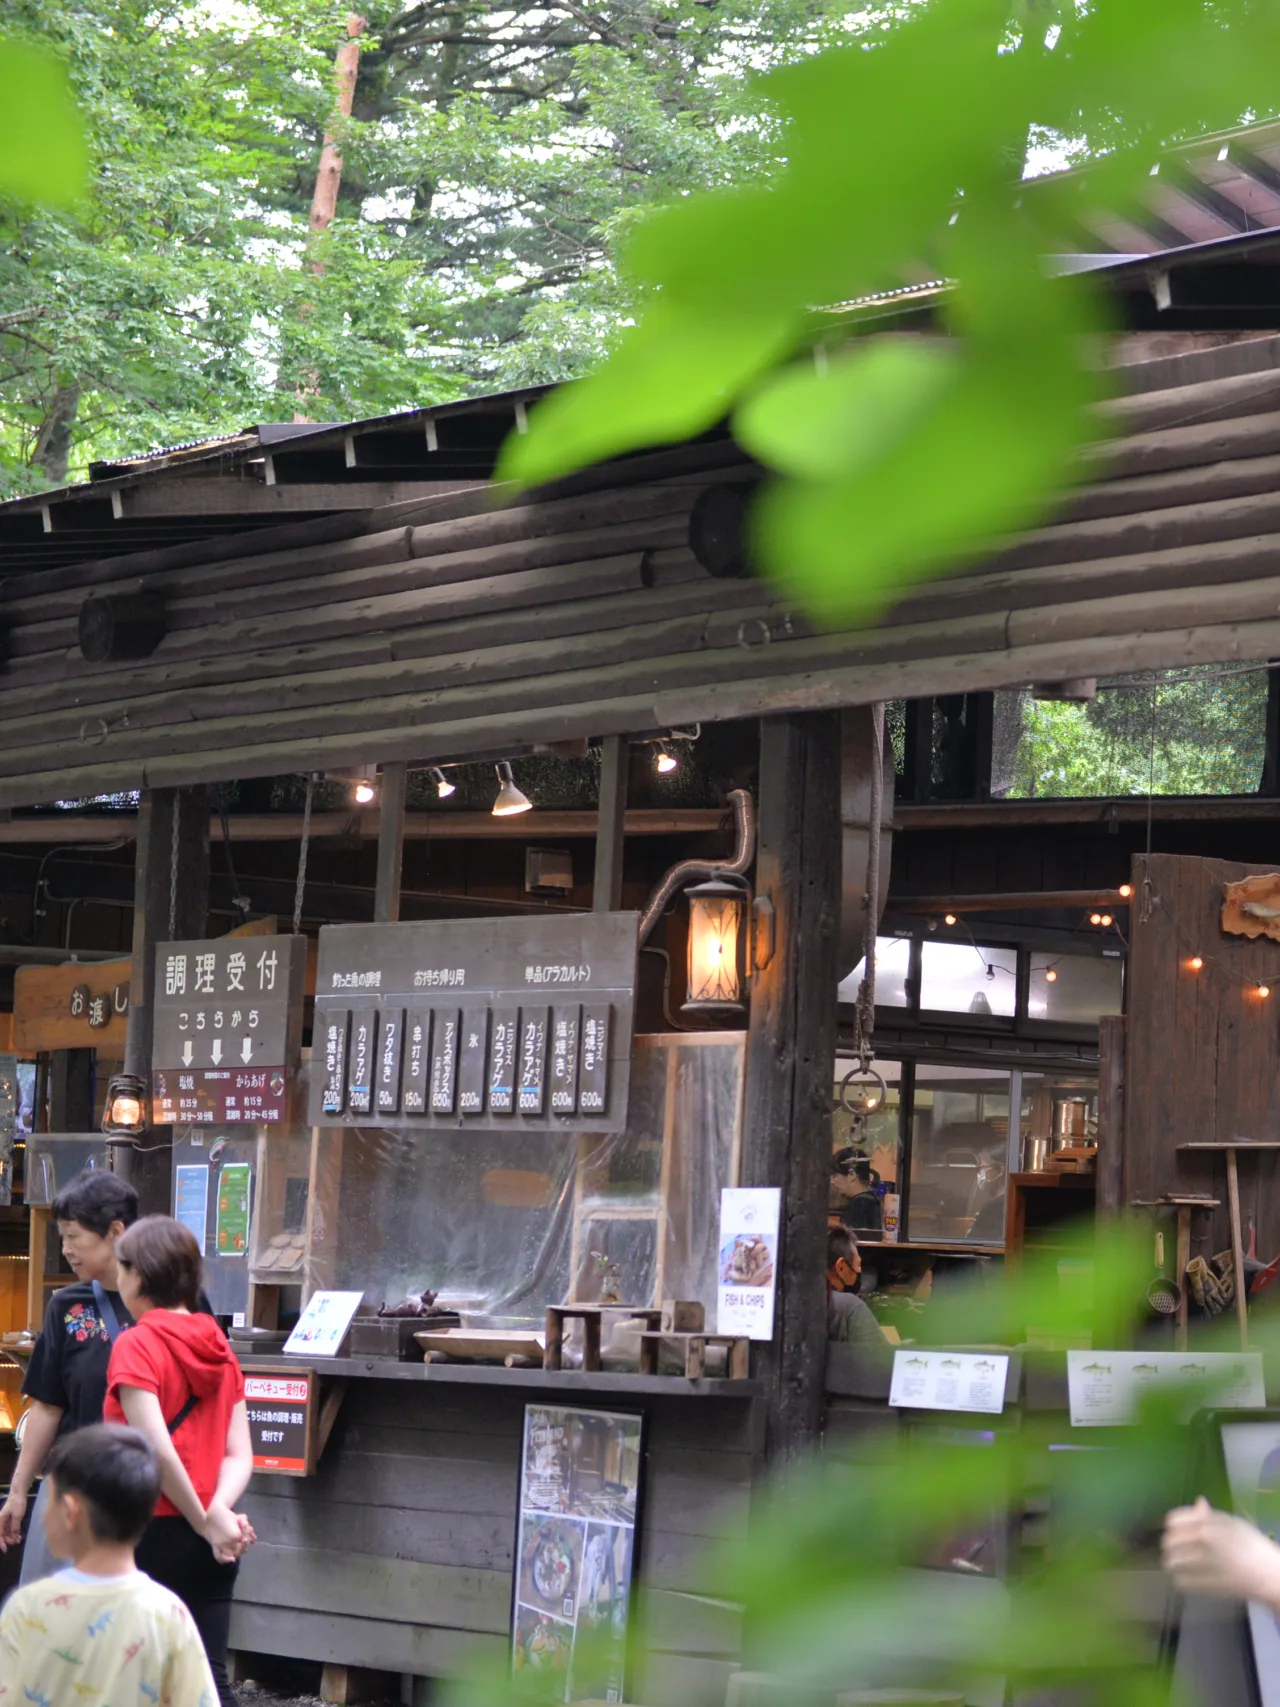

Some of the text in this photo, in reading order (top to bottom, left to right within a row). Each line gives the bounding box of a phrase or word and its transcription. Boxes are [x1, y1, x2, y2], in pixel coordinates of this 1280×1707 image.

[166, 950, 278, 995] 調理受付
[332, 971, 382, 988] 釣った魚の調理
[414, 969, 465, 986] お持ち帰り用
[178, 1009, 260, 1031] こちらから
[468, 1033, 479, 1048] 氷
[326, 1025, 338, 1072] 塩焼き
[355, 1025, 368, 1085] カラアゲ
[382, 1023, 396, 1083] ワタ抜き
[411, 1025, 422, 1076] 串打ち
[440, 1022, 454, 1093] アイスボックス
[493, 1023, 506, 1087] カラアゲ
[522, 1022, 536, 1086] カラアゲ
[554, 1021, 567, 1077] 塩焼き
[584, 1019, 596, 1071] 塩焼き
[236, 1073, 266, 1089] からあげ
[725, 1293, 739, 1307] FISH
[746, 1294, 765, 1308] CHIPS
[261, 1430, 284, 1443] 受付です
